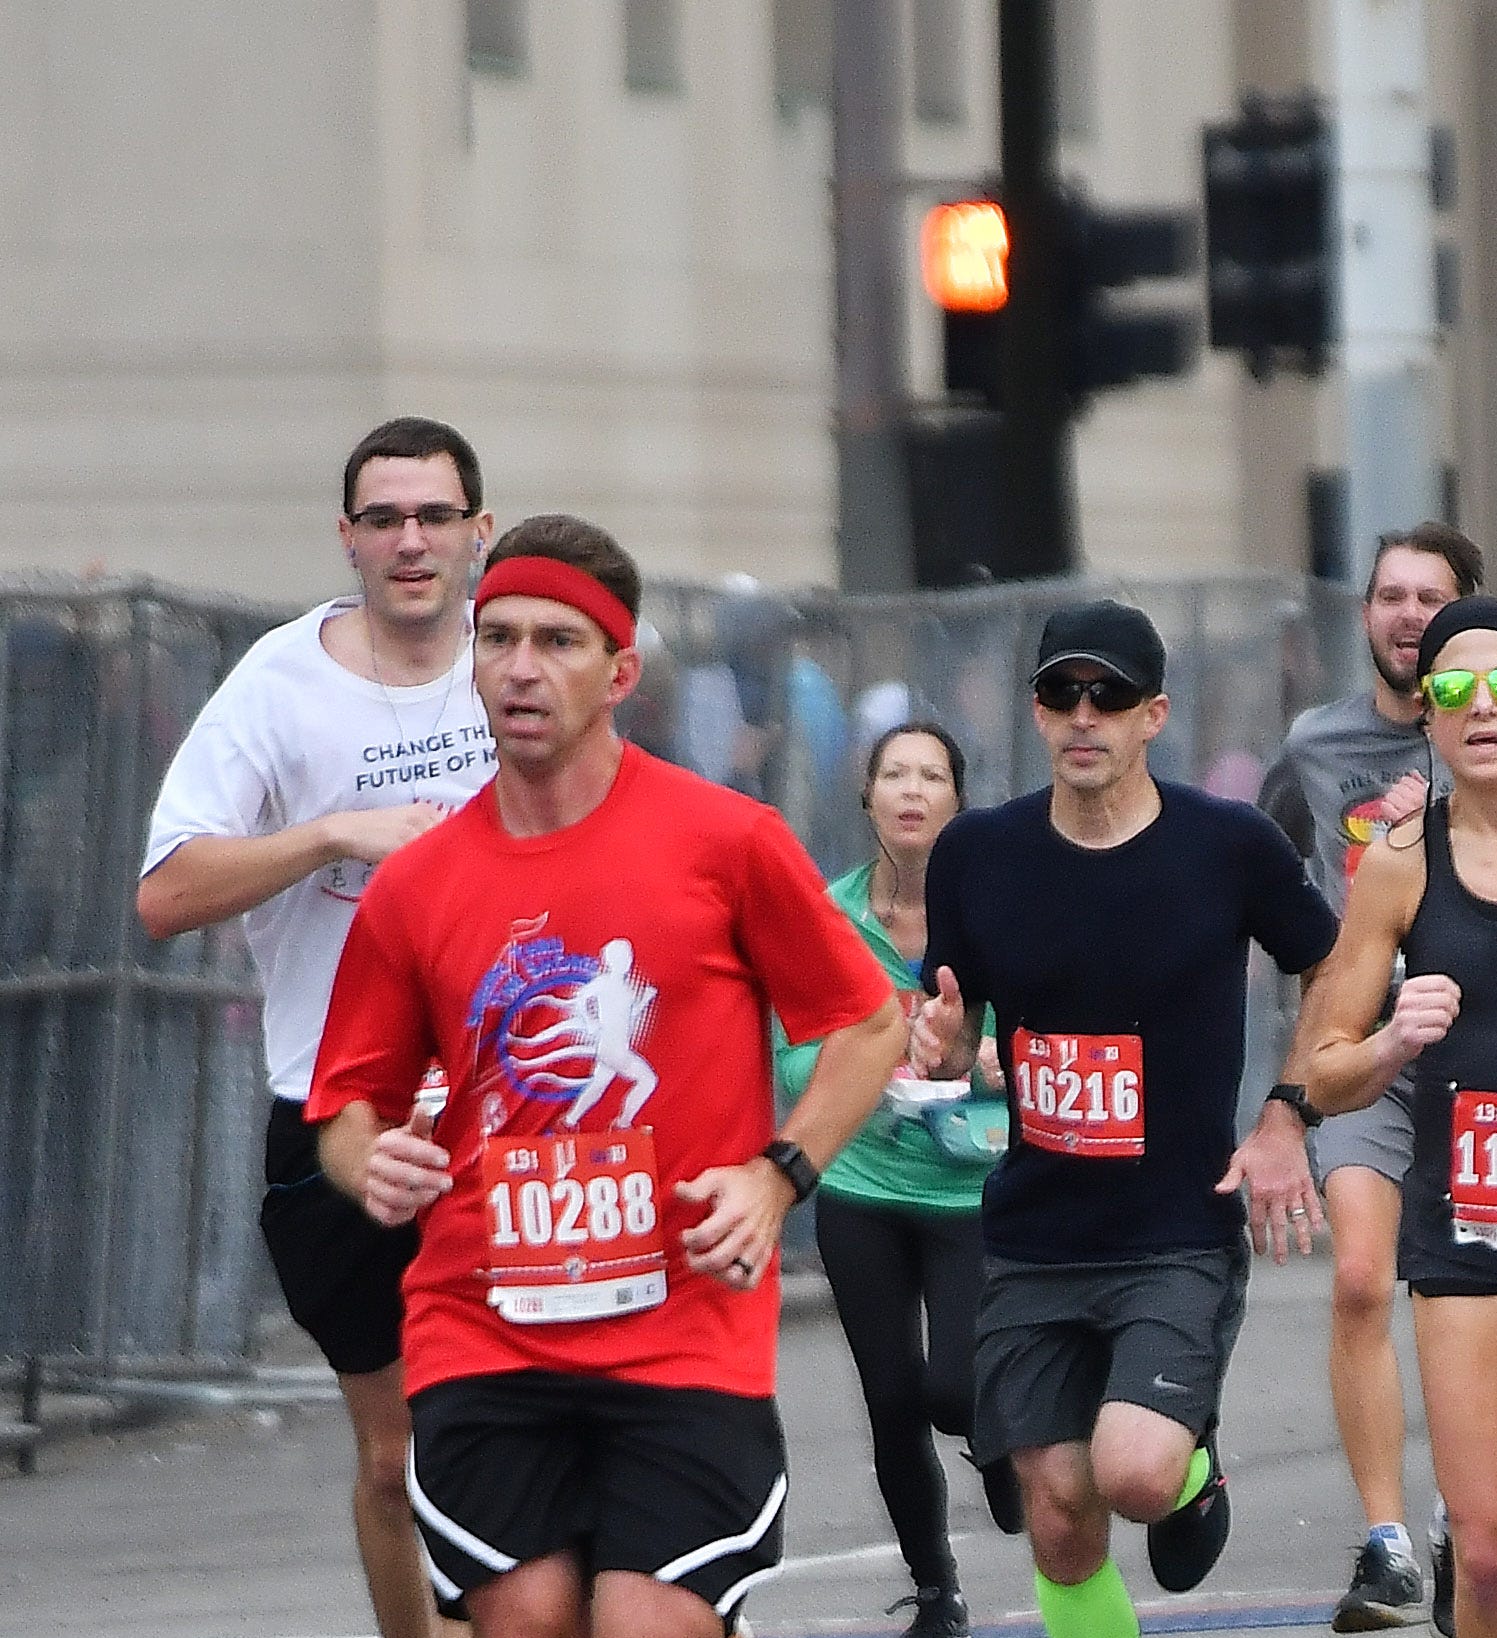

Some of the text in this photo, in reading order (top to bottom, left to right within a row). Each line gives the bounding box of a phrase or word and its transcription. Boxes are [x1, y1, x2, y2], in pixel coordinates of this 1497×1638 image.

[362, 731, 455, 763] CHANGE
[459, 724, 488, 743] TH
[356, 760, 441, 792] FUTURE
[446, 751, 477, 773] OF
[1018, 1060, 1139, 1122] 16216
[488, 1171, 657, 1247] 10288
